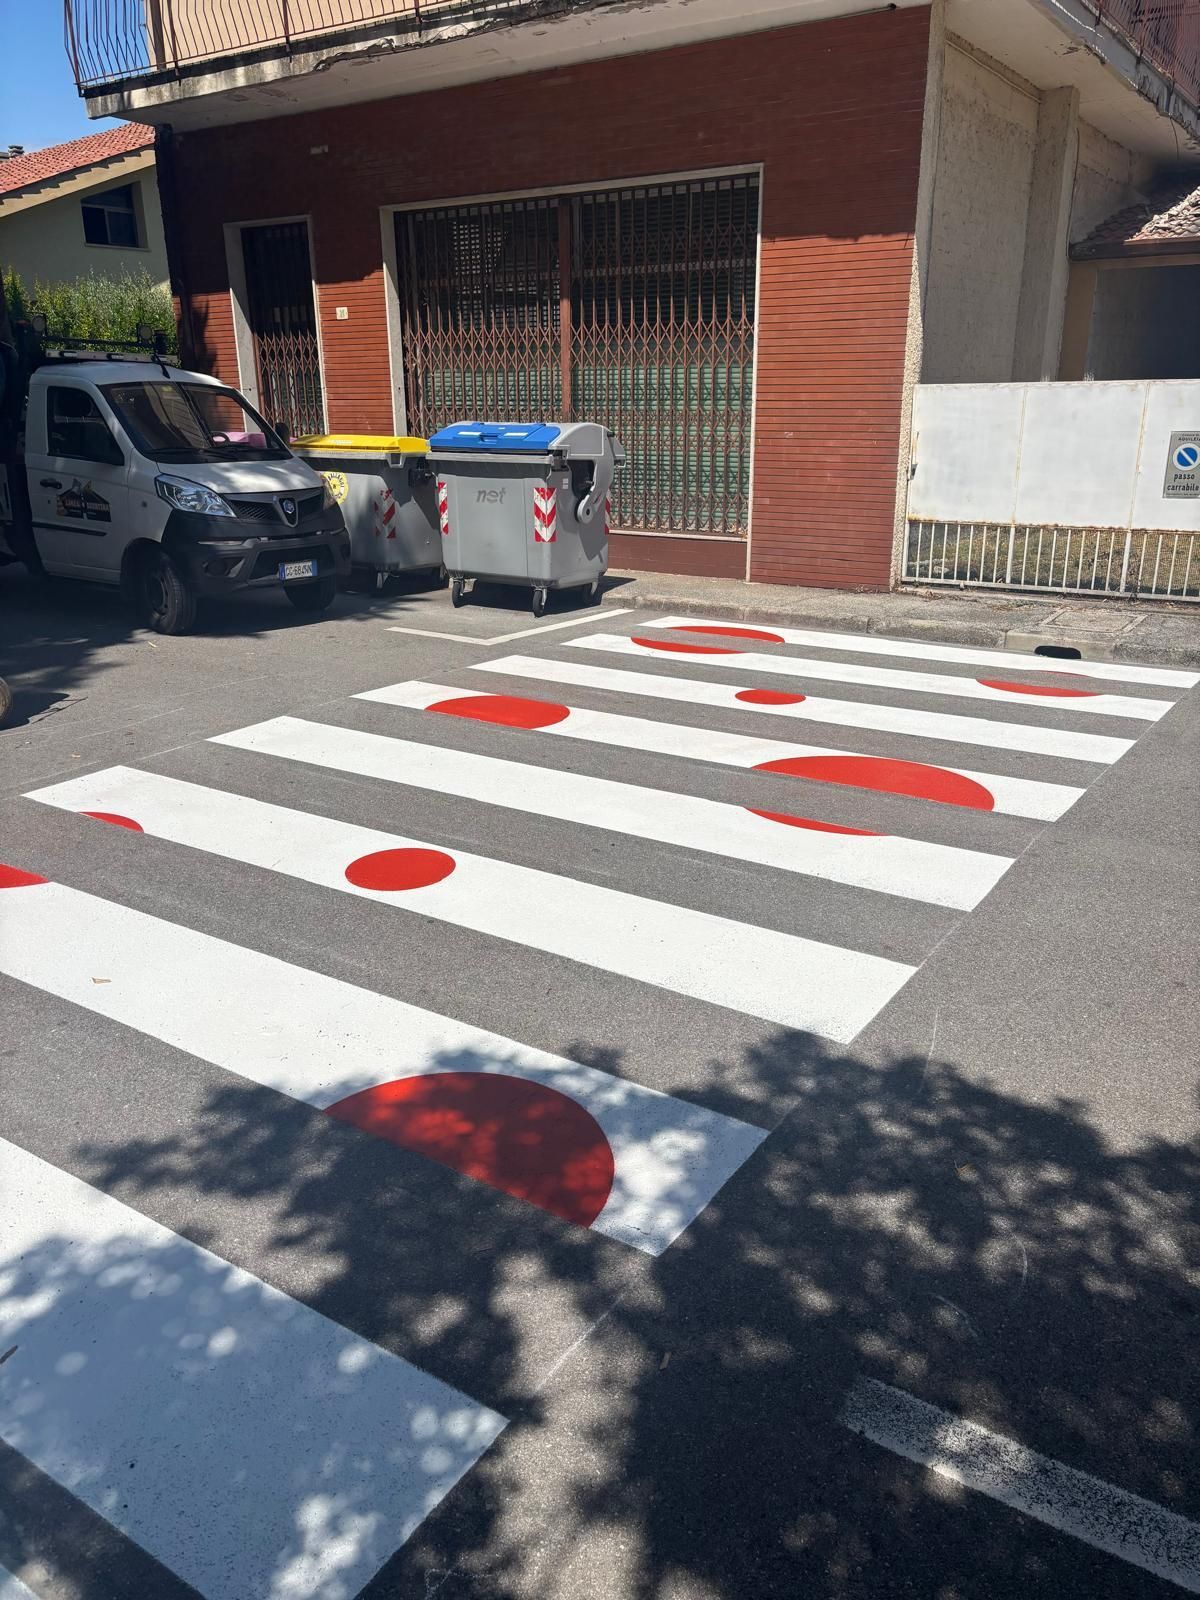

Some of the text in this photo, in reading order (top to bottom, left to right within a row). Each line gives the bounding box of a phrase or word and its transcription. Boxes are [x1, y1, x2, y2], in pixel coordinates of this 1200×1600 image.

[1174, 473, 1195, 482] passo
[1167, 483, 1199, 491] carrabile
[476, 487, 506, 504] net
